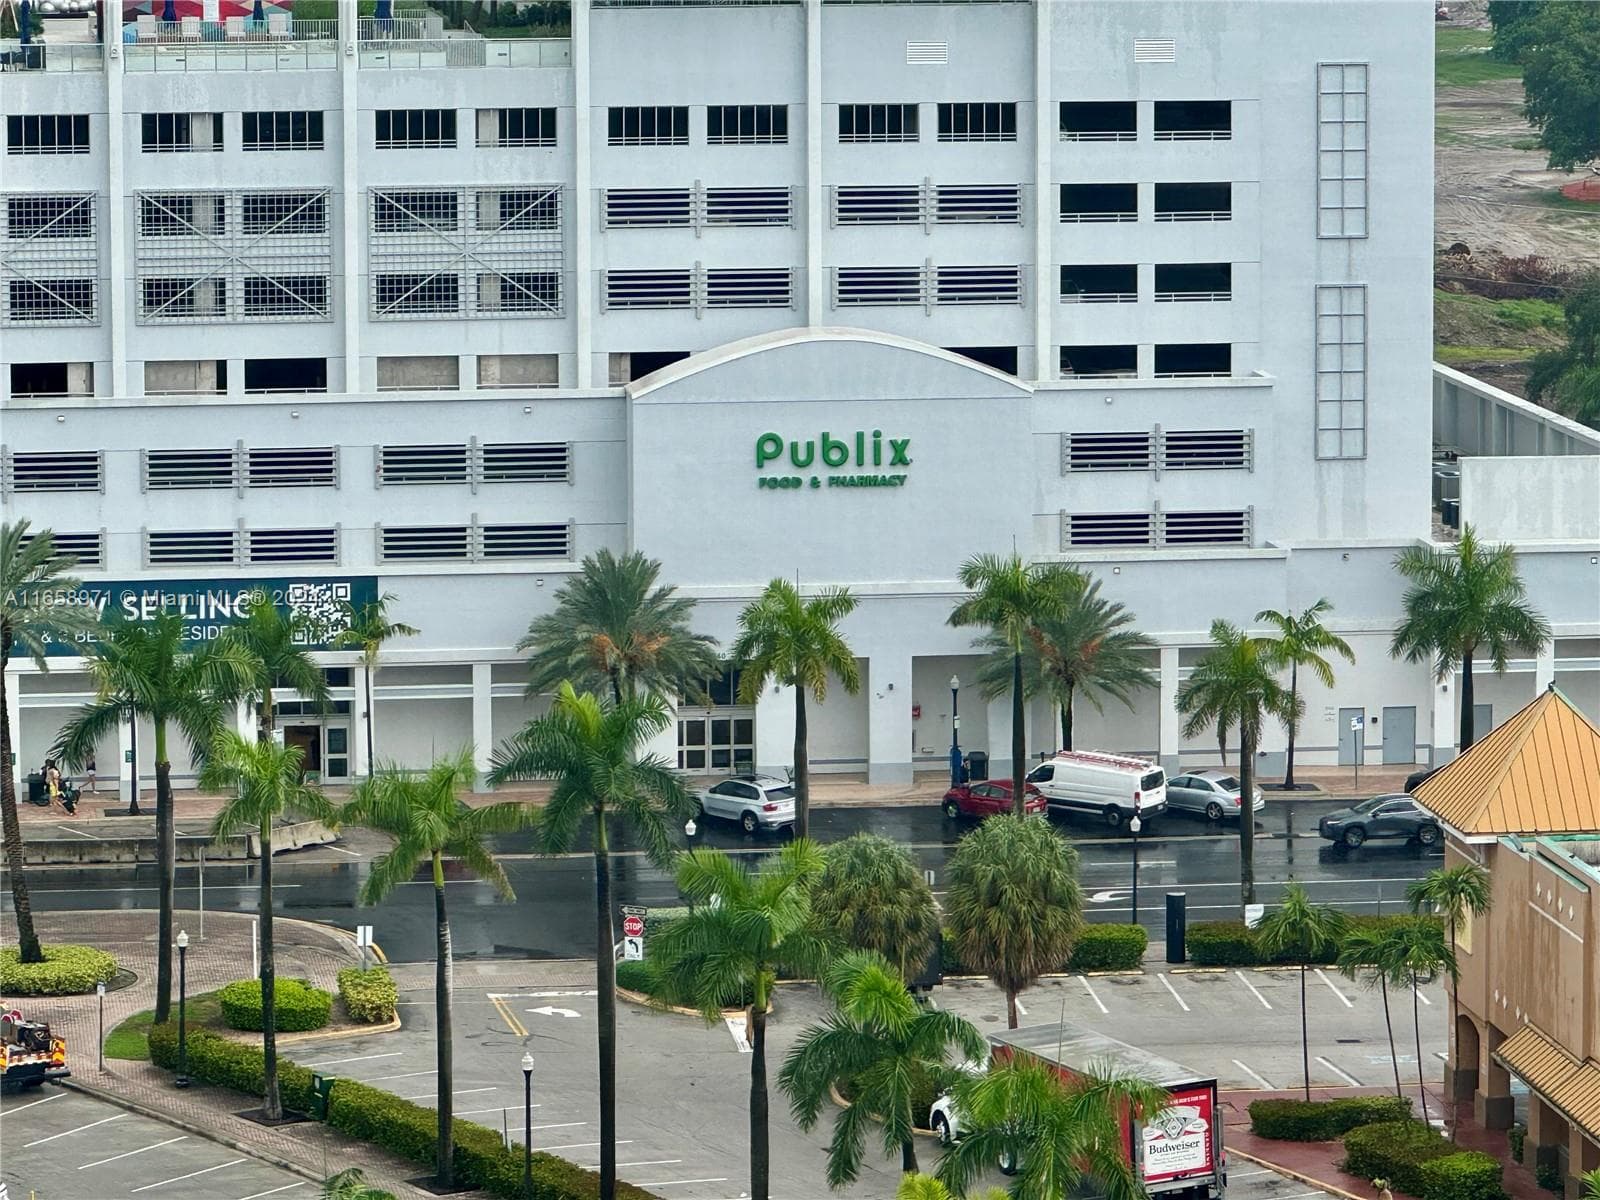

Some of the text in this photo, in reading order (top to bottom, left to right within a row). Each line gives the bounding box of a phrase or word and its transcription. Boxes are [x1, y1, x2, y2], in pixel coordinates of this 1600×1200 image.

[756, 430, 911, 468] Publix
[758, 474, 907, 489] FOOD & PHARMACY
[625, 922, 642, 930] STOP
[1149, 1140, 1200, 1155] Budweiser
